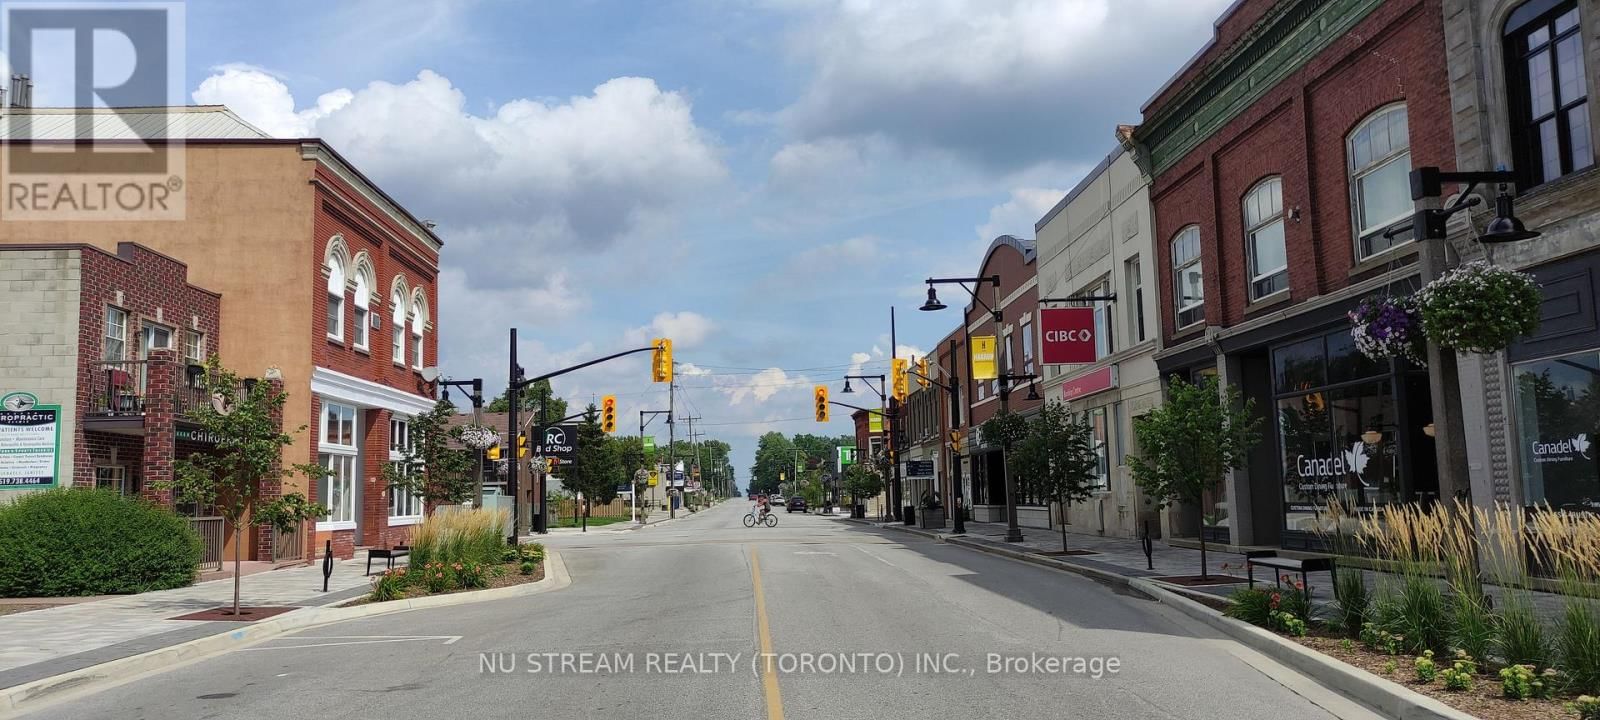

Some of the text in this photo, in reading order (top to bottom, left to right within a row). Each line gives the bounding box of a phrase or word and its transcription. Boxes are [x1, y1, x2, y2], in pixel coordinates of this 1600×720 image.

[1045, 330, 1077, 342] CIBC
[552, 444, 573, 453] Shop
[1532, 438, 1573, 455] Canadel
[1297, 451, 1347, 477] Canadel
